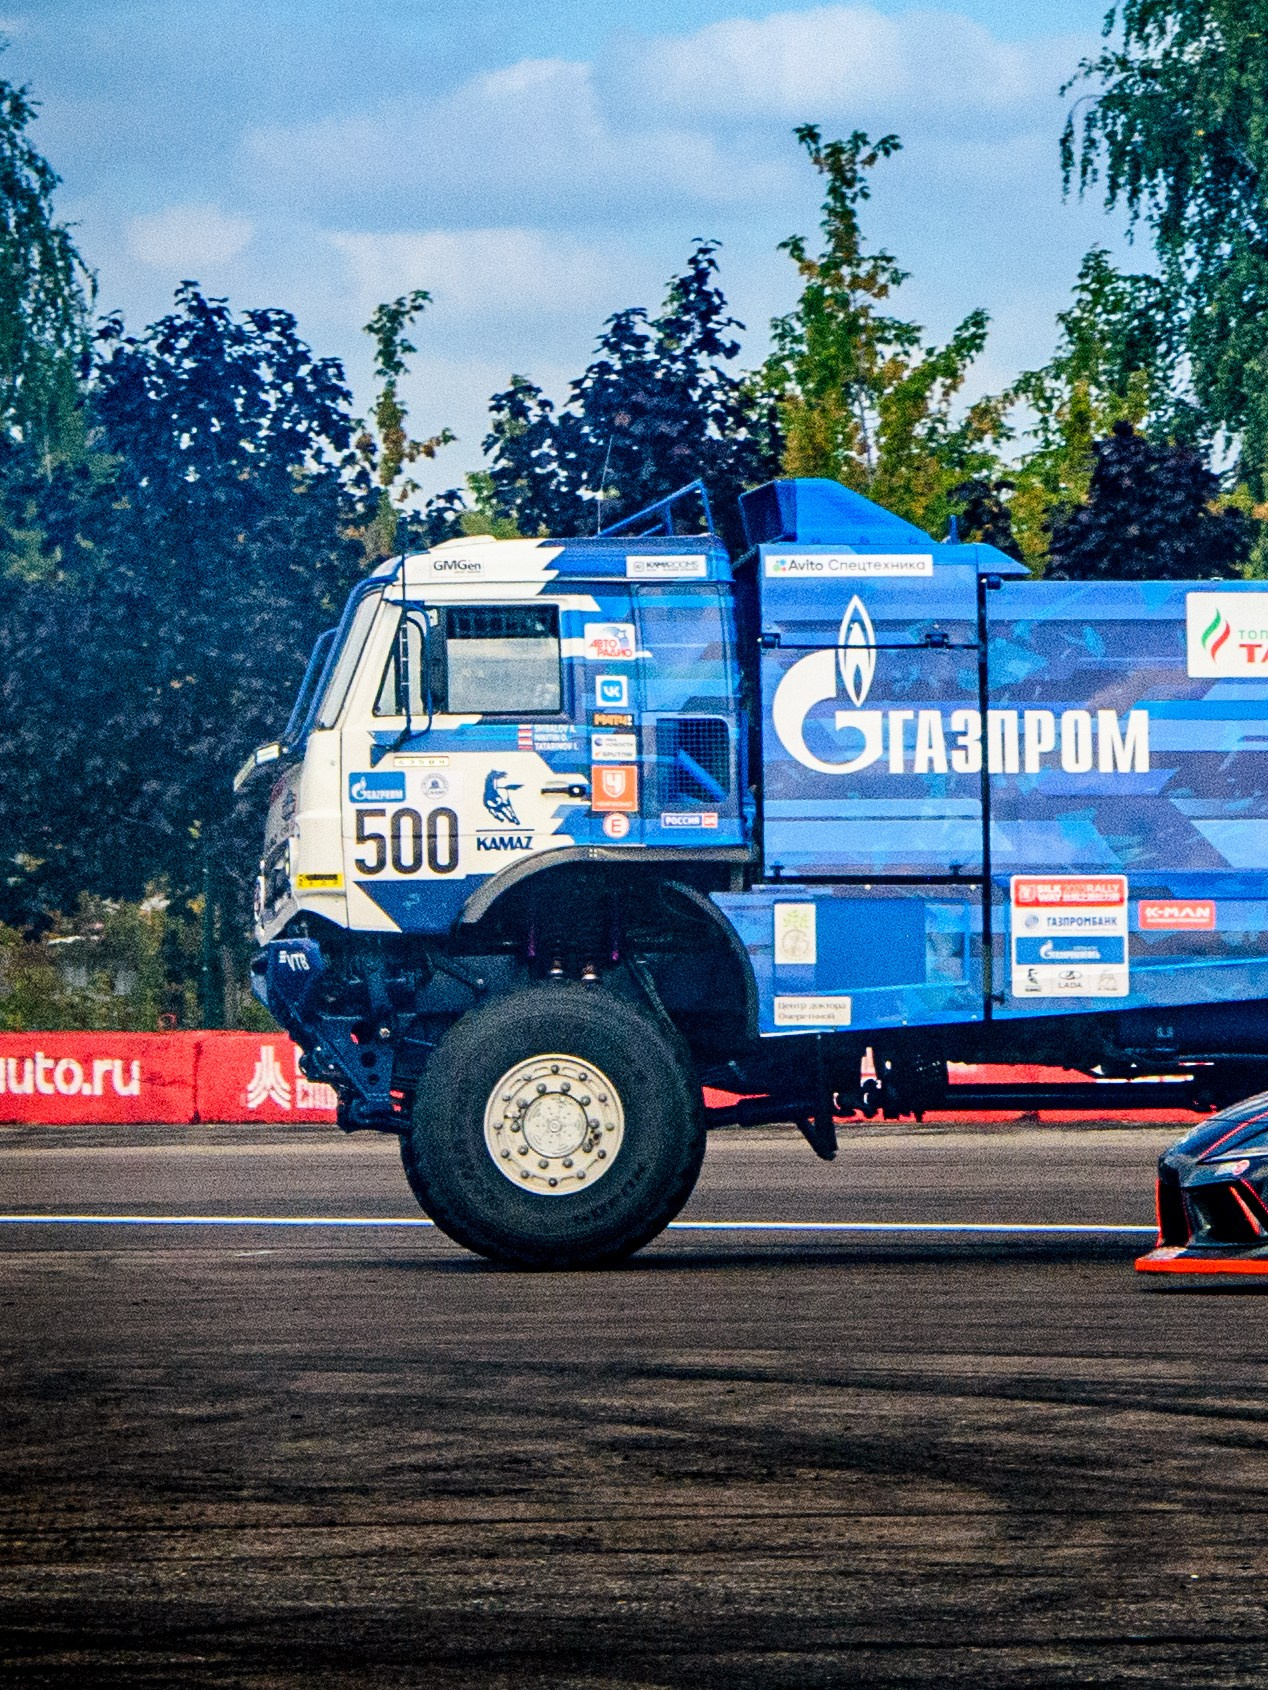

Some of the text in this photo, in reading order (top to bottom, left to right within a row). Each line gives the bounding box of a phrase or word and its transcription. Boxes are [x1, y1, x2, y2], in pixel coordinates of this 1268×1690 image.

[788, 557, 926, 573] Avito Спецтехника
[889, 709, 1150, 774] ГАЗПРОМ
[354, 806, 460, 876] 500
[476, 836, 534, 851] KAMAZ
[1145, 906, 1211, 918] K-MAN
[1047, 916, 1117, 927] ГАЗПРОМБАНК
